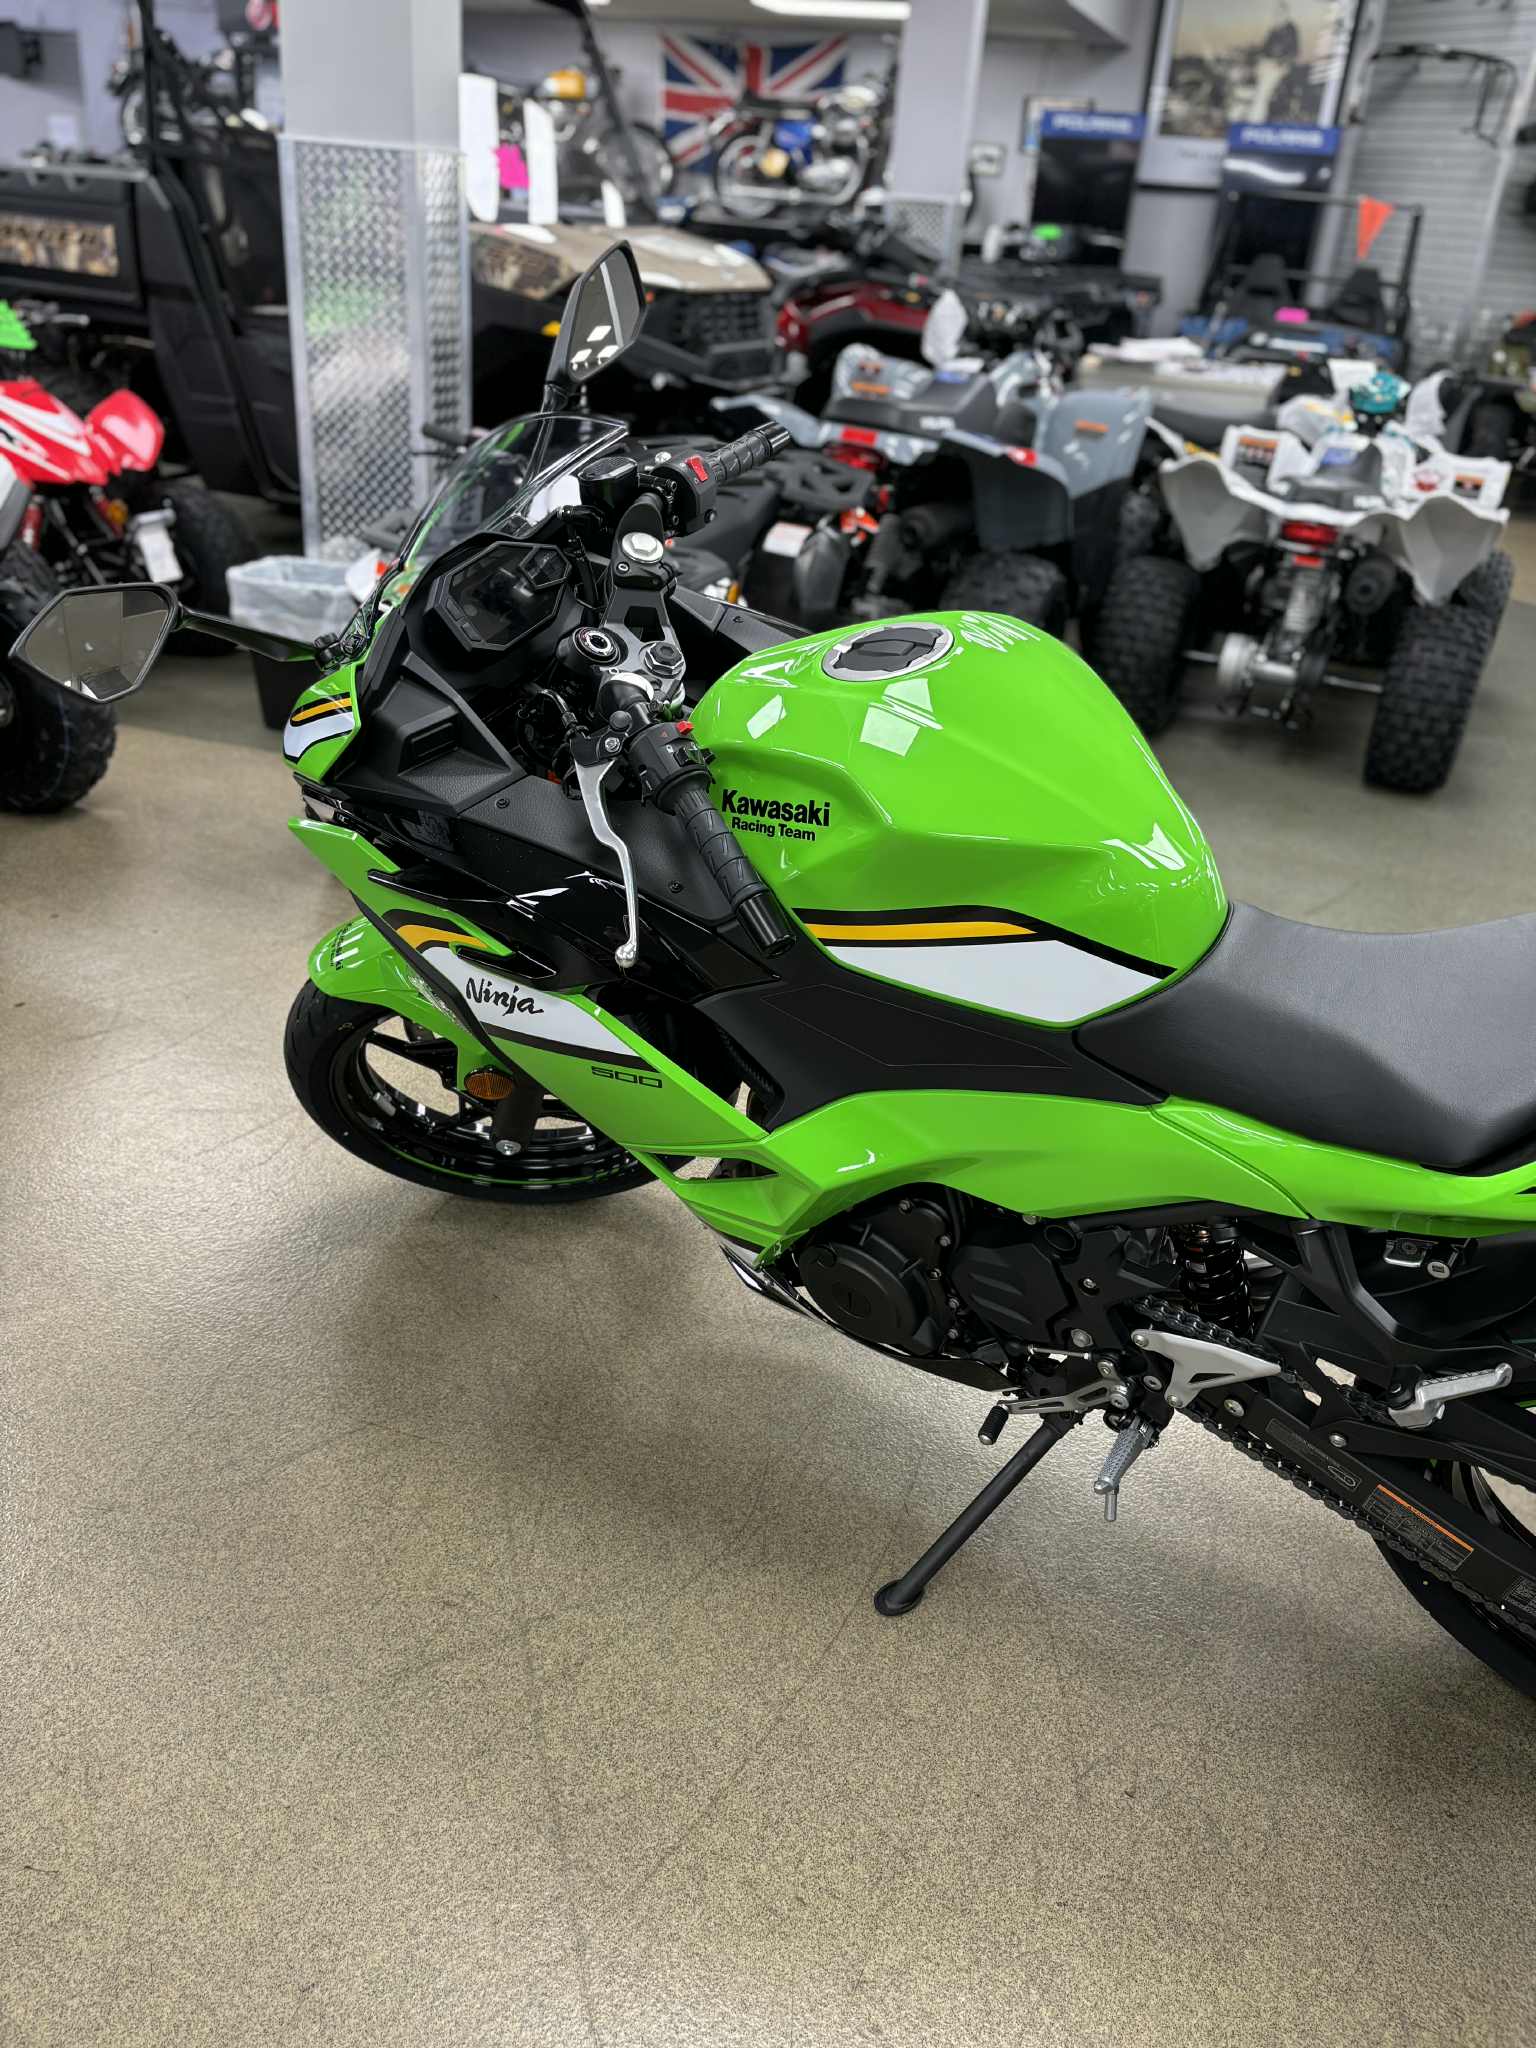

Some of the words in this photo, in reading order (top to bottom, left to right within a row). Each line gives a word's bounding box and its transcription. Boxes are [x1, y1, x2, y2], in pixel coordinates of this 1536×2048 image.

[721, 788, 831, 827] Kawasaki
[731, 816, 776, 838] Racing
[778, 822, 816, 842] Team
[465, 977, 545, 1017] Ninja
[591, 1065, 663, 1089] 500
